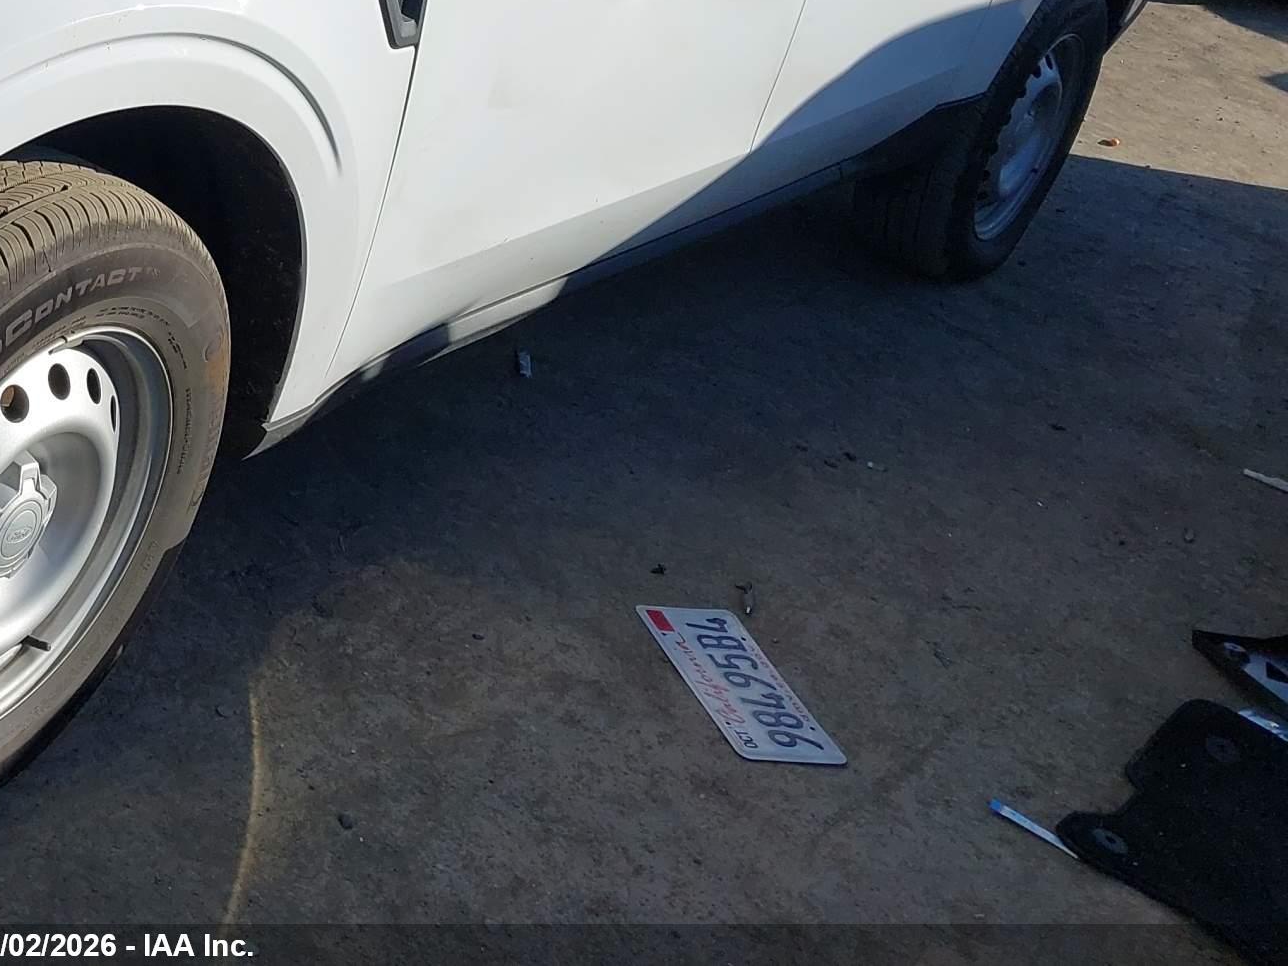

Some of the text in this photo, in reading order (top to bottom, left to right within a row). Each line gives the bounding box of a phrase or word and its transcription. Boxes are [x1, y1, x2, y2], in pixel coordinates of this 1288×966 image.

[674, 632, 758, 749] OCT California
[685, 617, 824, 751] 98495B4
